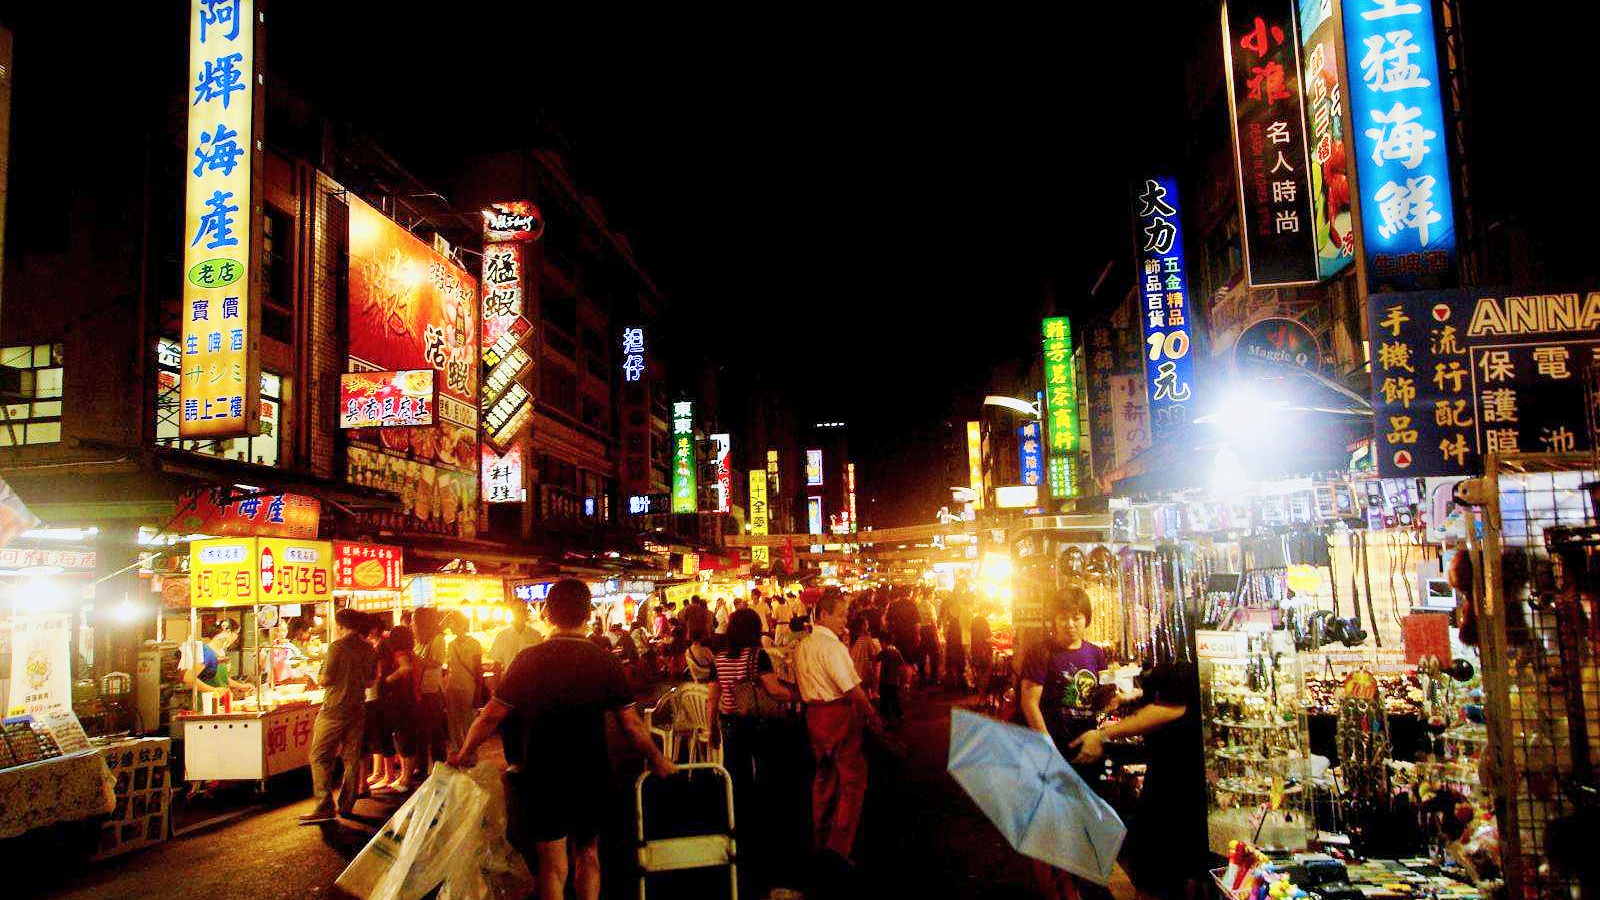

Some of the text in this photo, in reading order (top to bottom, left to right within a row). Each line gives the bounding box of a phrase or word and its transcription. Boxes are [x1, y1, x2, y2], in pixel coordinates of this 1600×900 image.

[191, 0, 246, 251] 阿輝海產
[1266, 121, 1299, 234] 名人時尚
[1139, 179, 1176, 254] 大力
[192, 297, 239, 322] 實價
[196, 265, 235, 285] 老店
[1144, 259, 1164, 328] 飾品百貨
[1164, 257, 1185, 326] 五金精品
[186, 328, 243, 355] 生啤酒
[186, 364, 242, 386] サシミ
[1380, 306, 1418, 445] 手機飾品
[185, 396, 242, 421] 請上二樓
[1431, 325, 1473, 466] 流行配件
[1479, 351, 1520, 454] 保護膜
